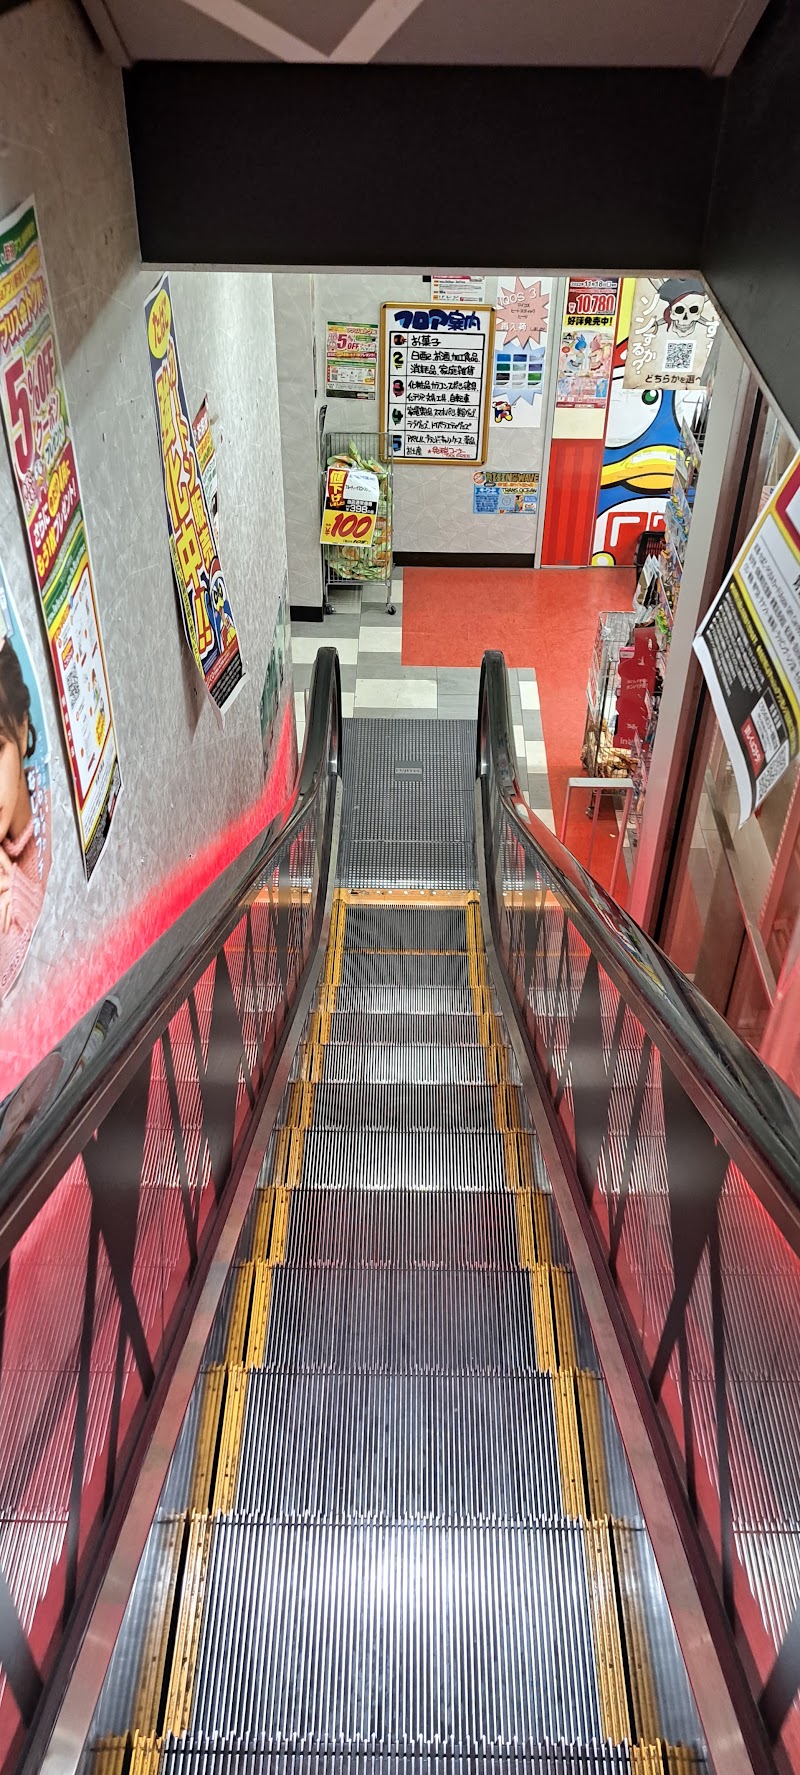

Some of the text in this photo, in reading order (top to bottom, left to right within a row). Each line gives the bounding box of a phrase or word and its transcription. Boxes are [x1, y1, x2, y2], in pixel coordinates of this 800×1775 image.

[529, 288, 537, 299] 3
[394, 309, 481, 331] フロア案内
[411, 335, 441, 346] お菓子
[329, 470, 347, 502] 値下げ
